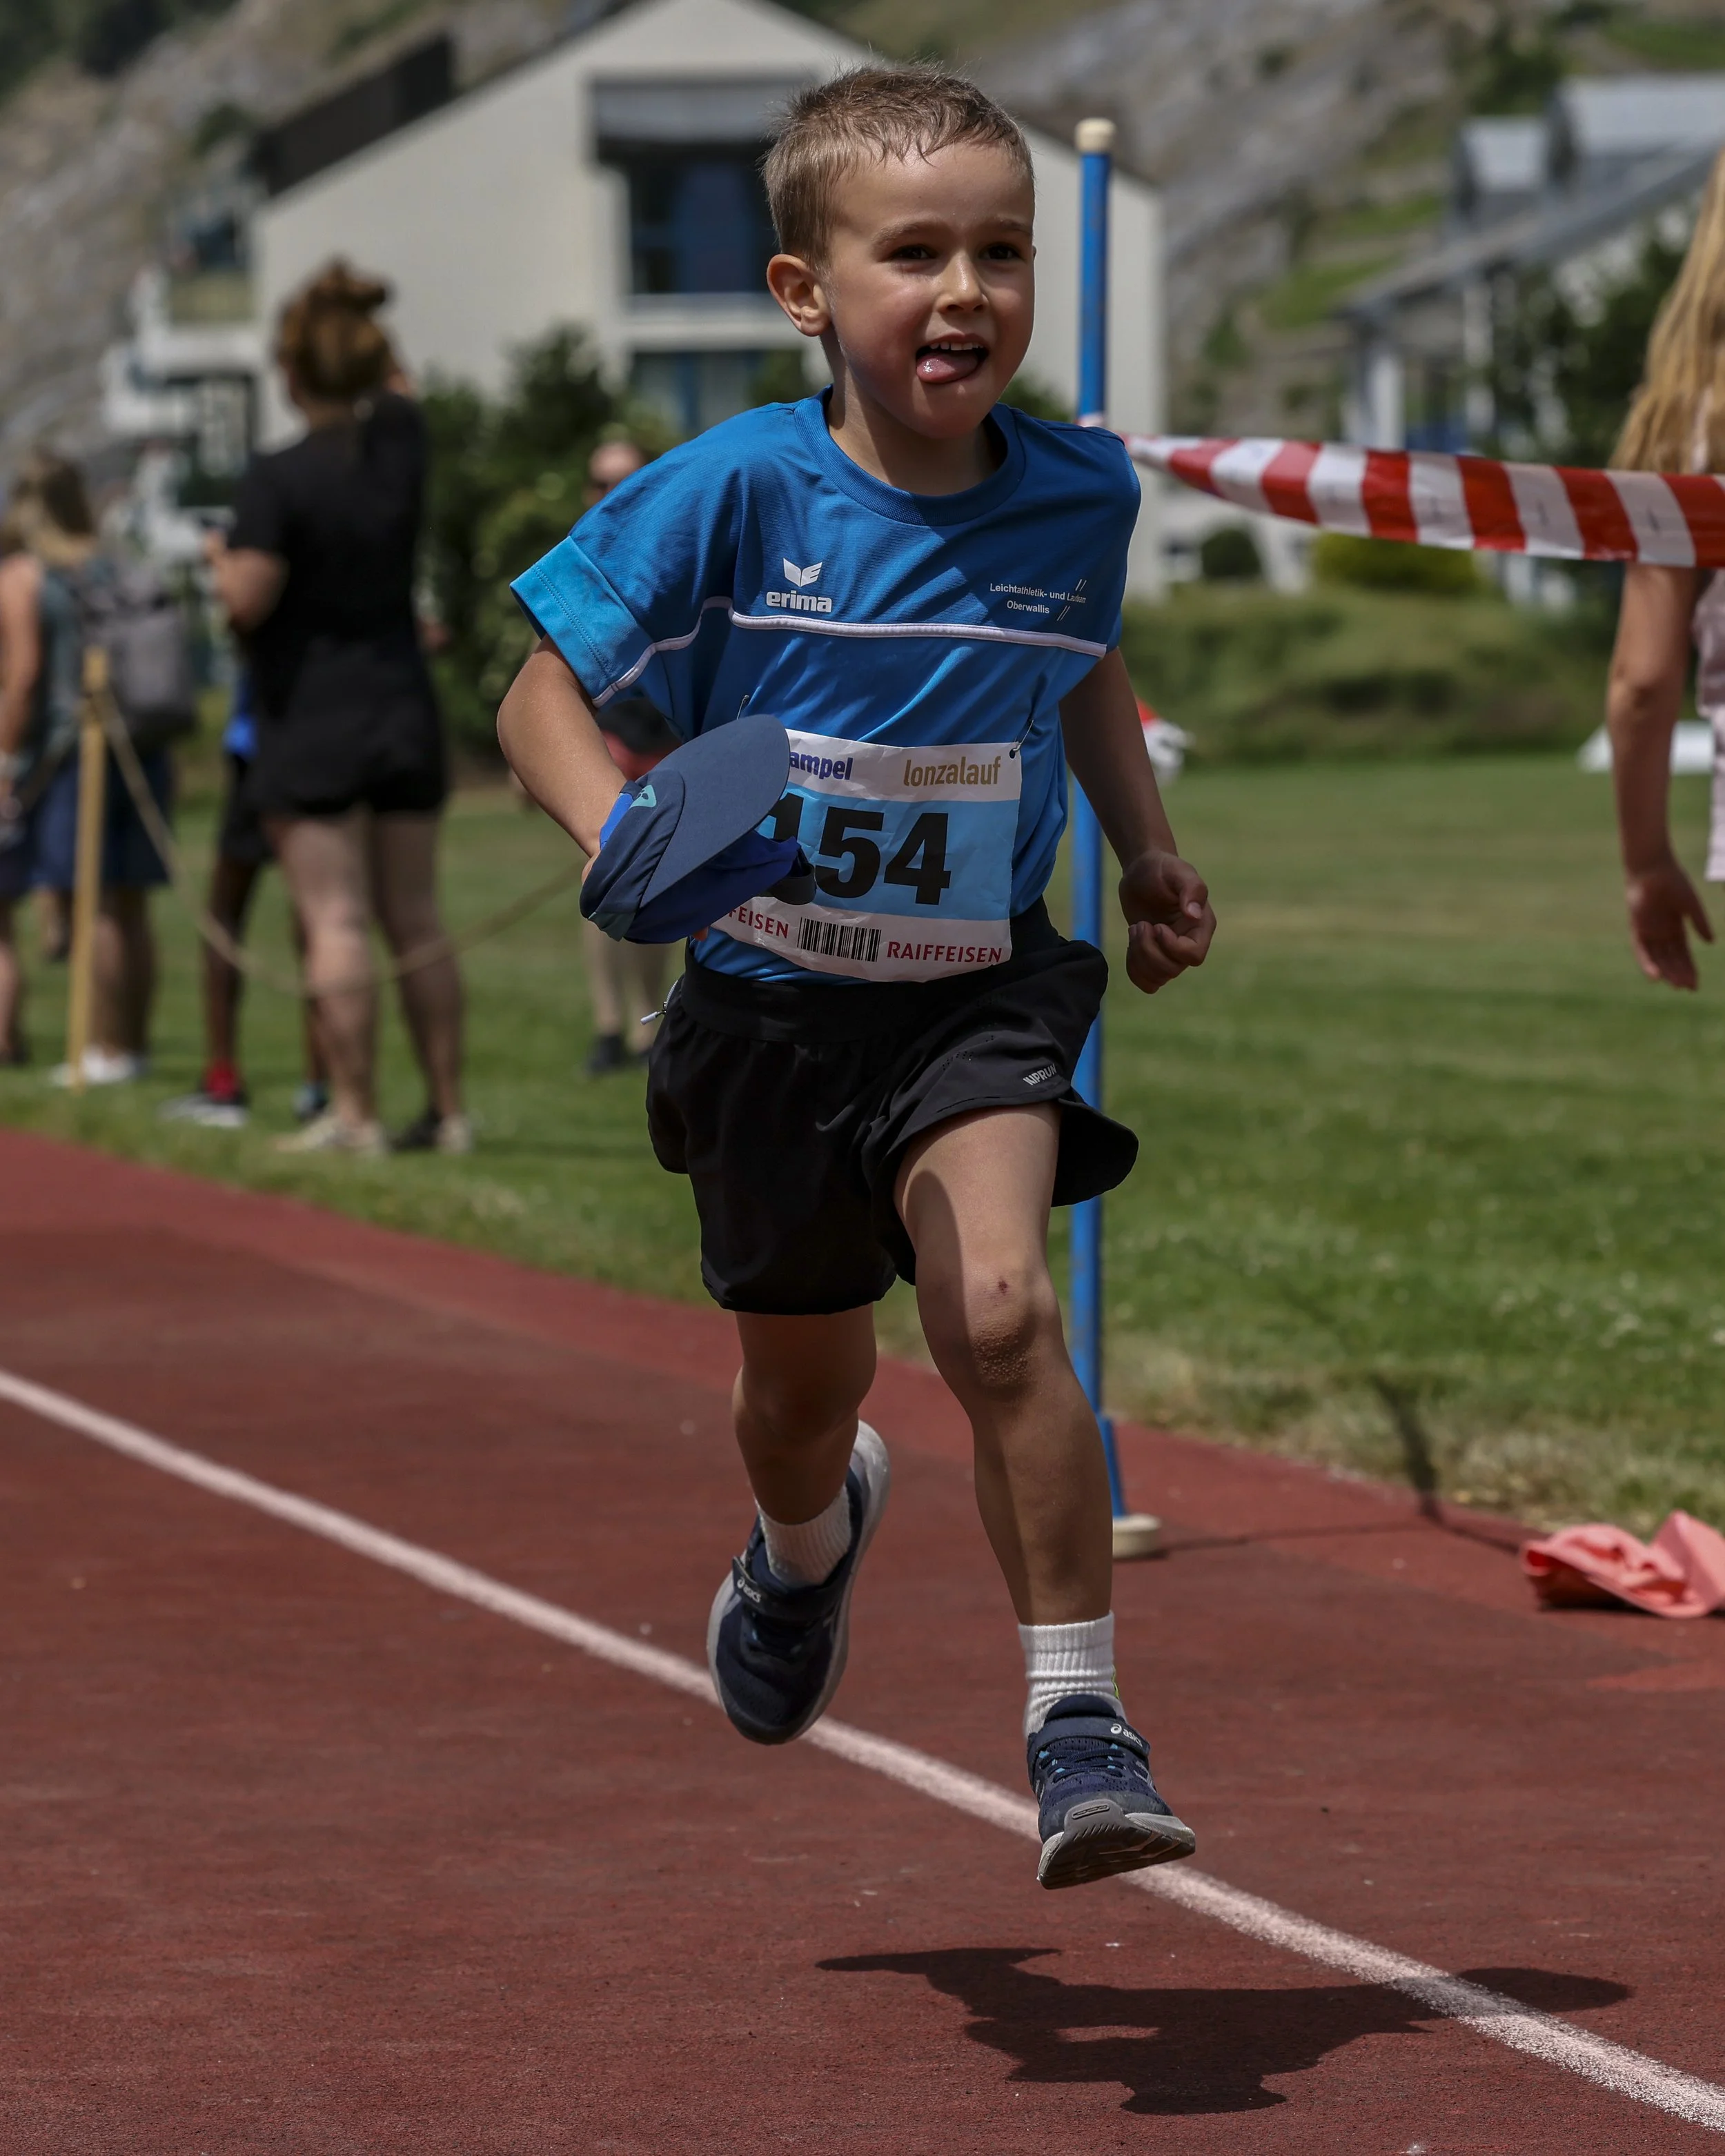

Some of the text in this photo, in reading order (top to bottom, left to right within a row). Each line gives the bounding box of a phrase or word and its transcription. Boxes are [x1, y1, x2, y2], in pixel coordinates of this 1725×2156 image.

[766, 590, 832, 613] erima
[989, 582, 1047, 597] Leichtathletik-
[1049, 591, 1065, 600] und
[1007, 600, 1050, 614] Oberwallis
[789, 751, 854, 780] ampel
[903, 755, 1001, 787] lonzalauf
[887, 941, 1002, 962] RAIFFEISEN
